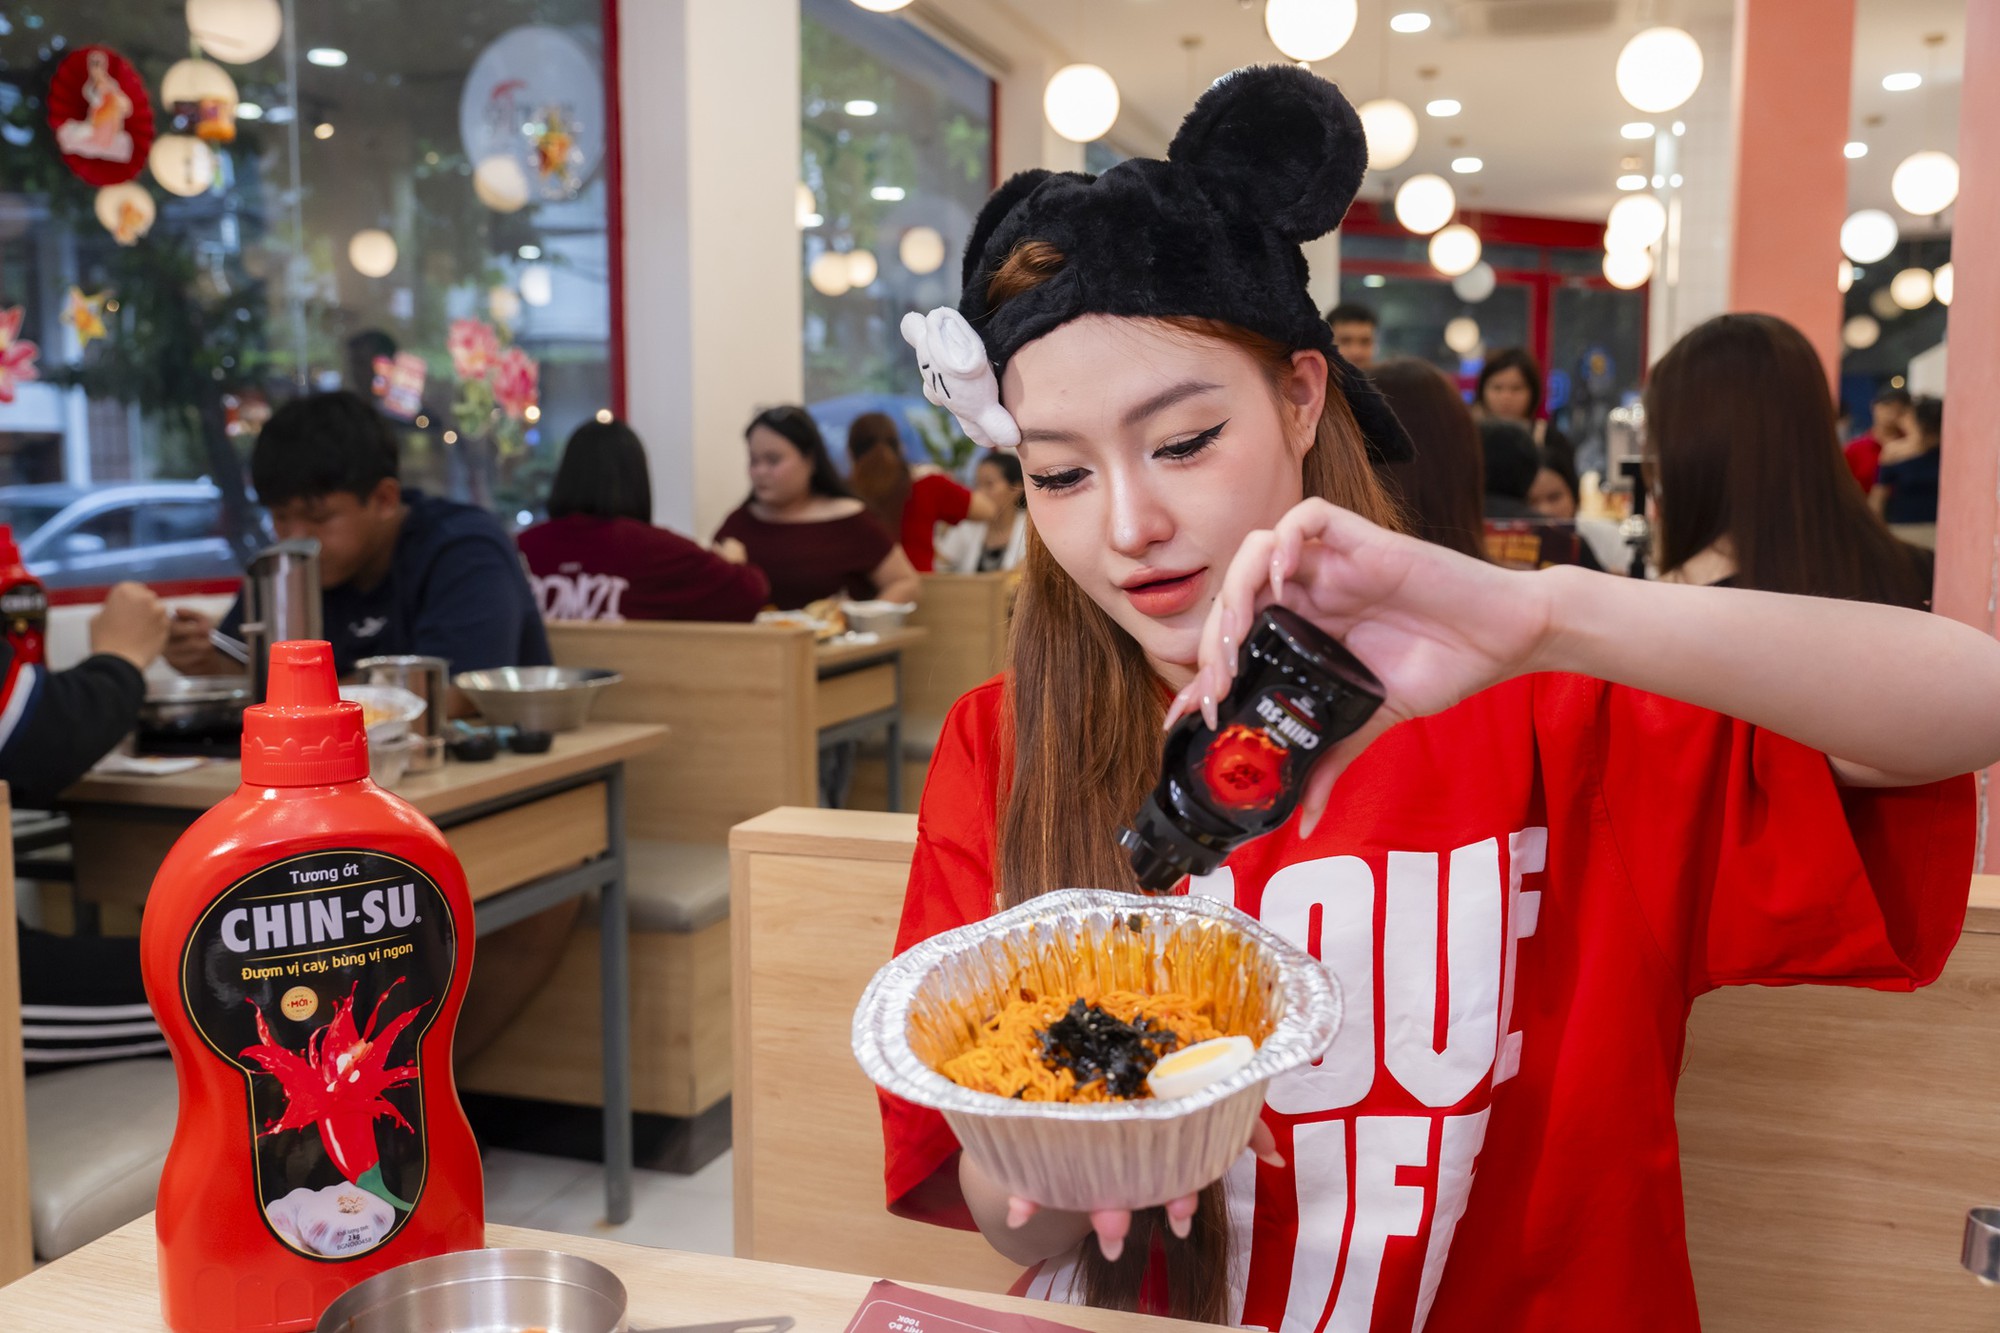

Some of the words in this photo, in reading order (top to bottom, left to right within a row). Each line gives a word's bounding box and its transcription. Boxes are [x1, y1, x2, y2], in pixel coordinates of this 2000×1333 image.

[1256, 698, 1319, 750] CHIN-SU
[289, 868, 339, 884] Tương
[343, 863, 359, 877] ớt
[220, 883, 416, 953] CHIN-SU
[241, 967, 284, 981] Đượm
[287, 962, 300, 976] vị
[302, 960, 330, 974] cay,
[332, 953, 367, 970] bùng
[368, 949, 381, 963] vị
[383, 943, 414, 960] ngon
[1189, 826, 1549, 1115] OVE
[1222, 1103, 1492, 1333] IF
[896, 1315, 920, 1327] 100K
